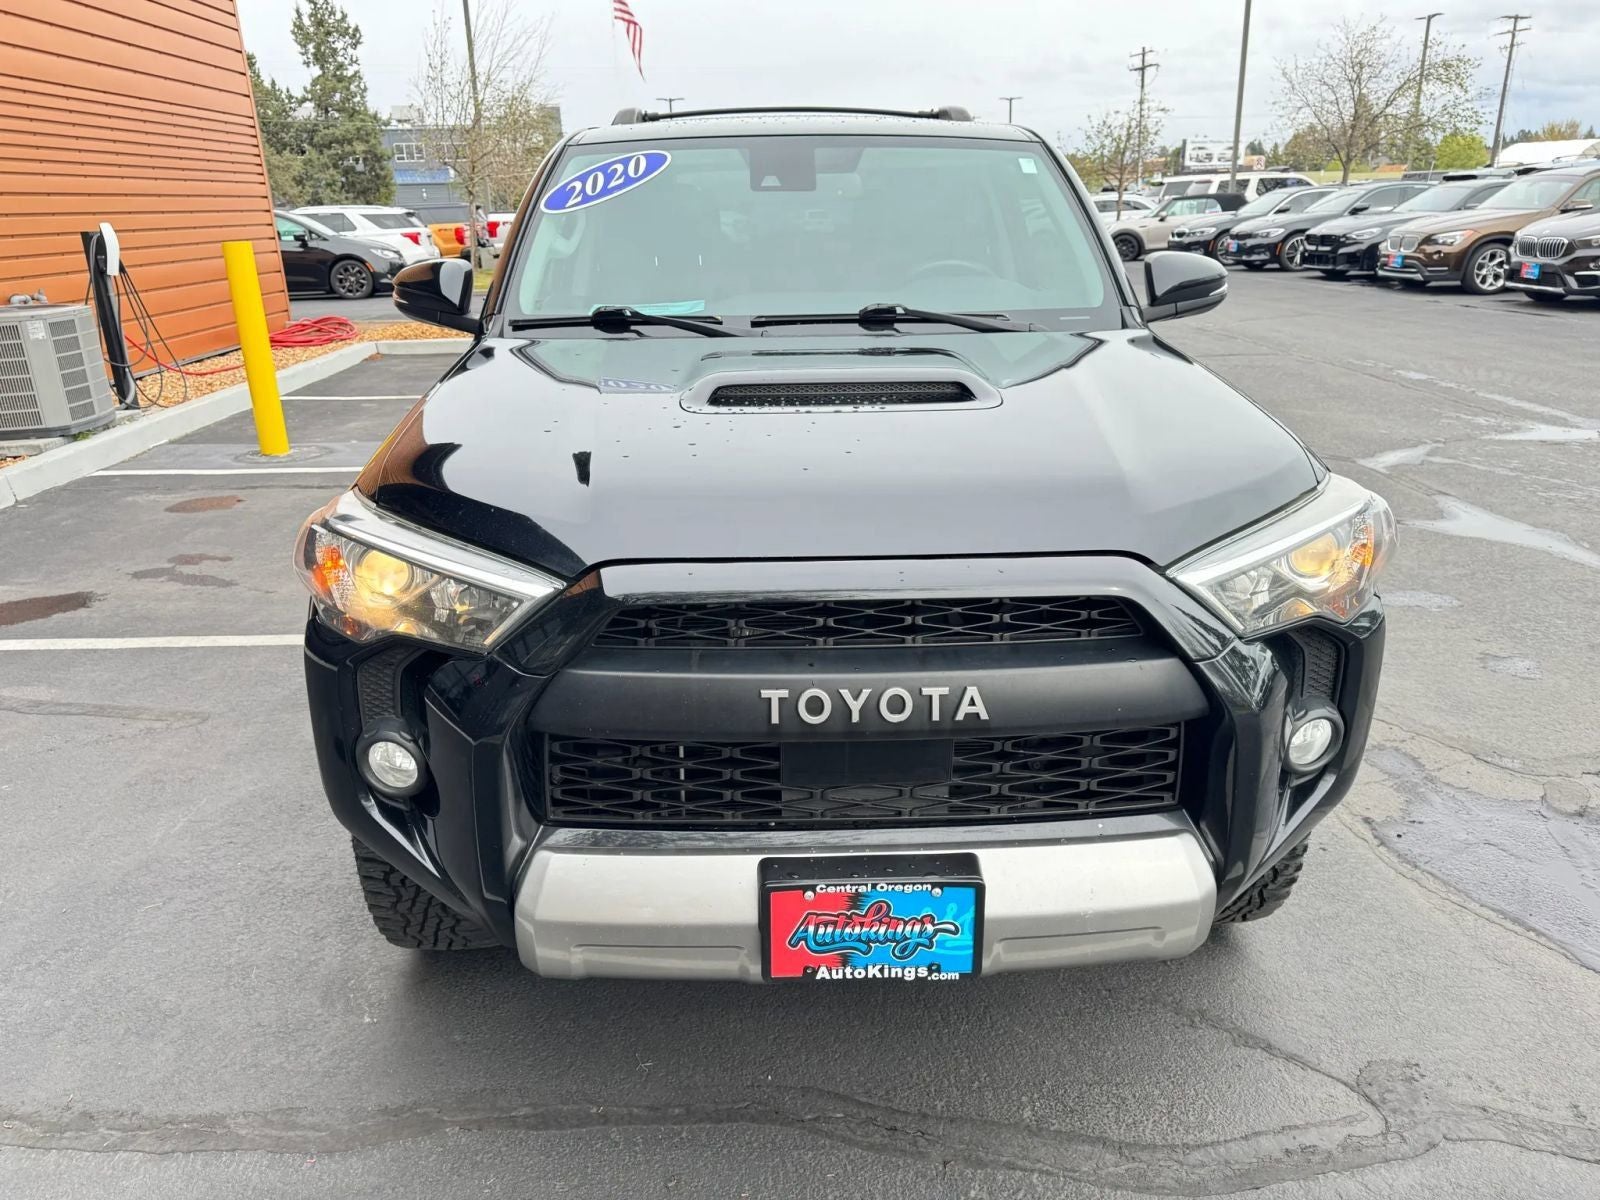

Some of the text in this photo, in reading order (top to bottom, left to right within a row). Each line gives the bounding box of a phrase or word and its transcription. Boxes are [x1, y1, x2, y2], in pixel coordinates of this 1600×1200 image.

[564, 154, 647, 208] 2020
[760, 686, 990, 725] TOYOTA
[815, 882, 932, 894] Central Oregon
[815, 964, 960, 981] AutoKings.com
